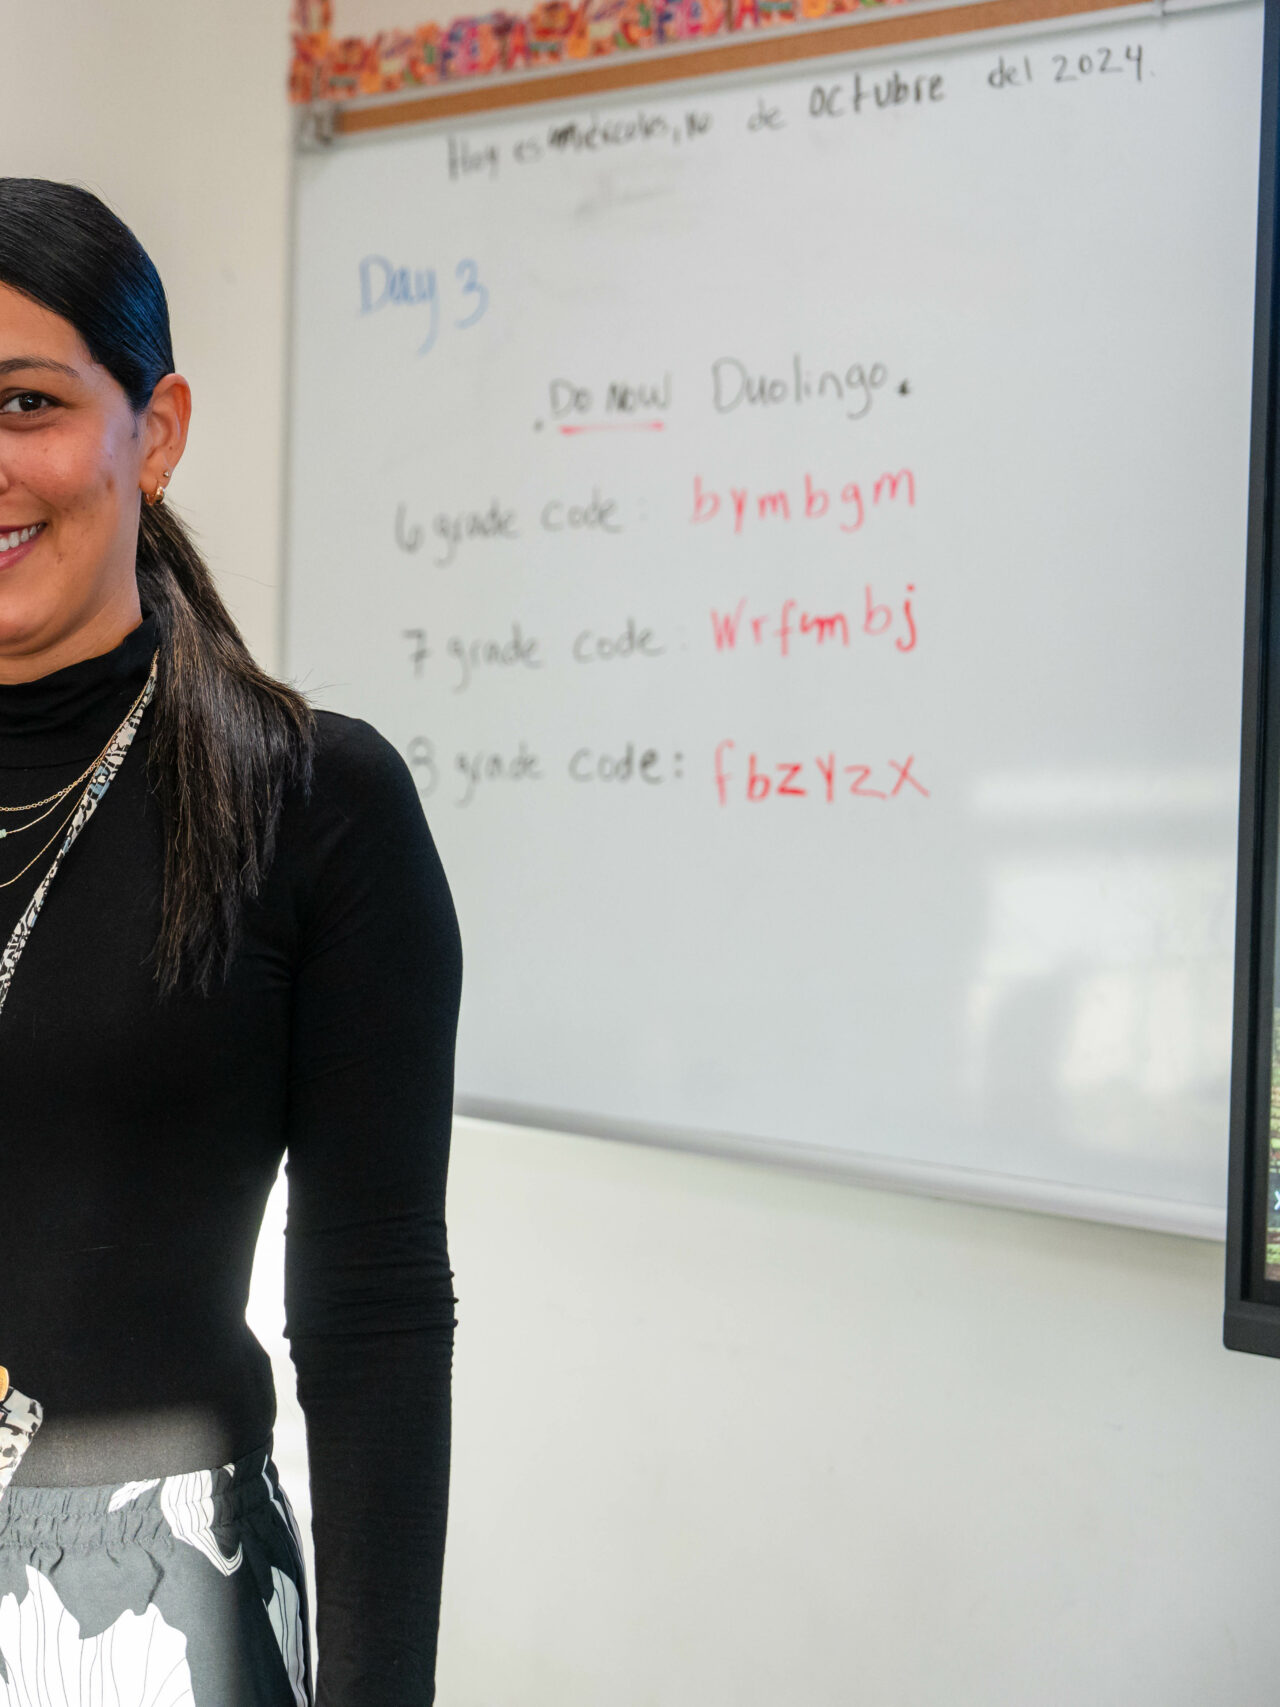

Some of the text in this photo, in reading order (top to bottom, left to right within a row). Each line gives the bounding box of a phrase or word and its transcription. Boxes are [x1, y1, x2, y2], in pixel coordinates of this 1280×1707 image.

[746, 96, 787, 134] de
[986, 55, 1034, 90] del
[358, 253, 489, 357] Day 3
[548, 377, 593, 419] Do
[393, 500, 427, 555] 6
[431, 495, 520, 570] grade
[400, 628, 432, 680] 7
[445, 619, 545, 695] grade
[405, 735, 440, 800] 8
[454, 739, 545, 809] grade
[568, 740, 684, 786] code:
